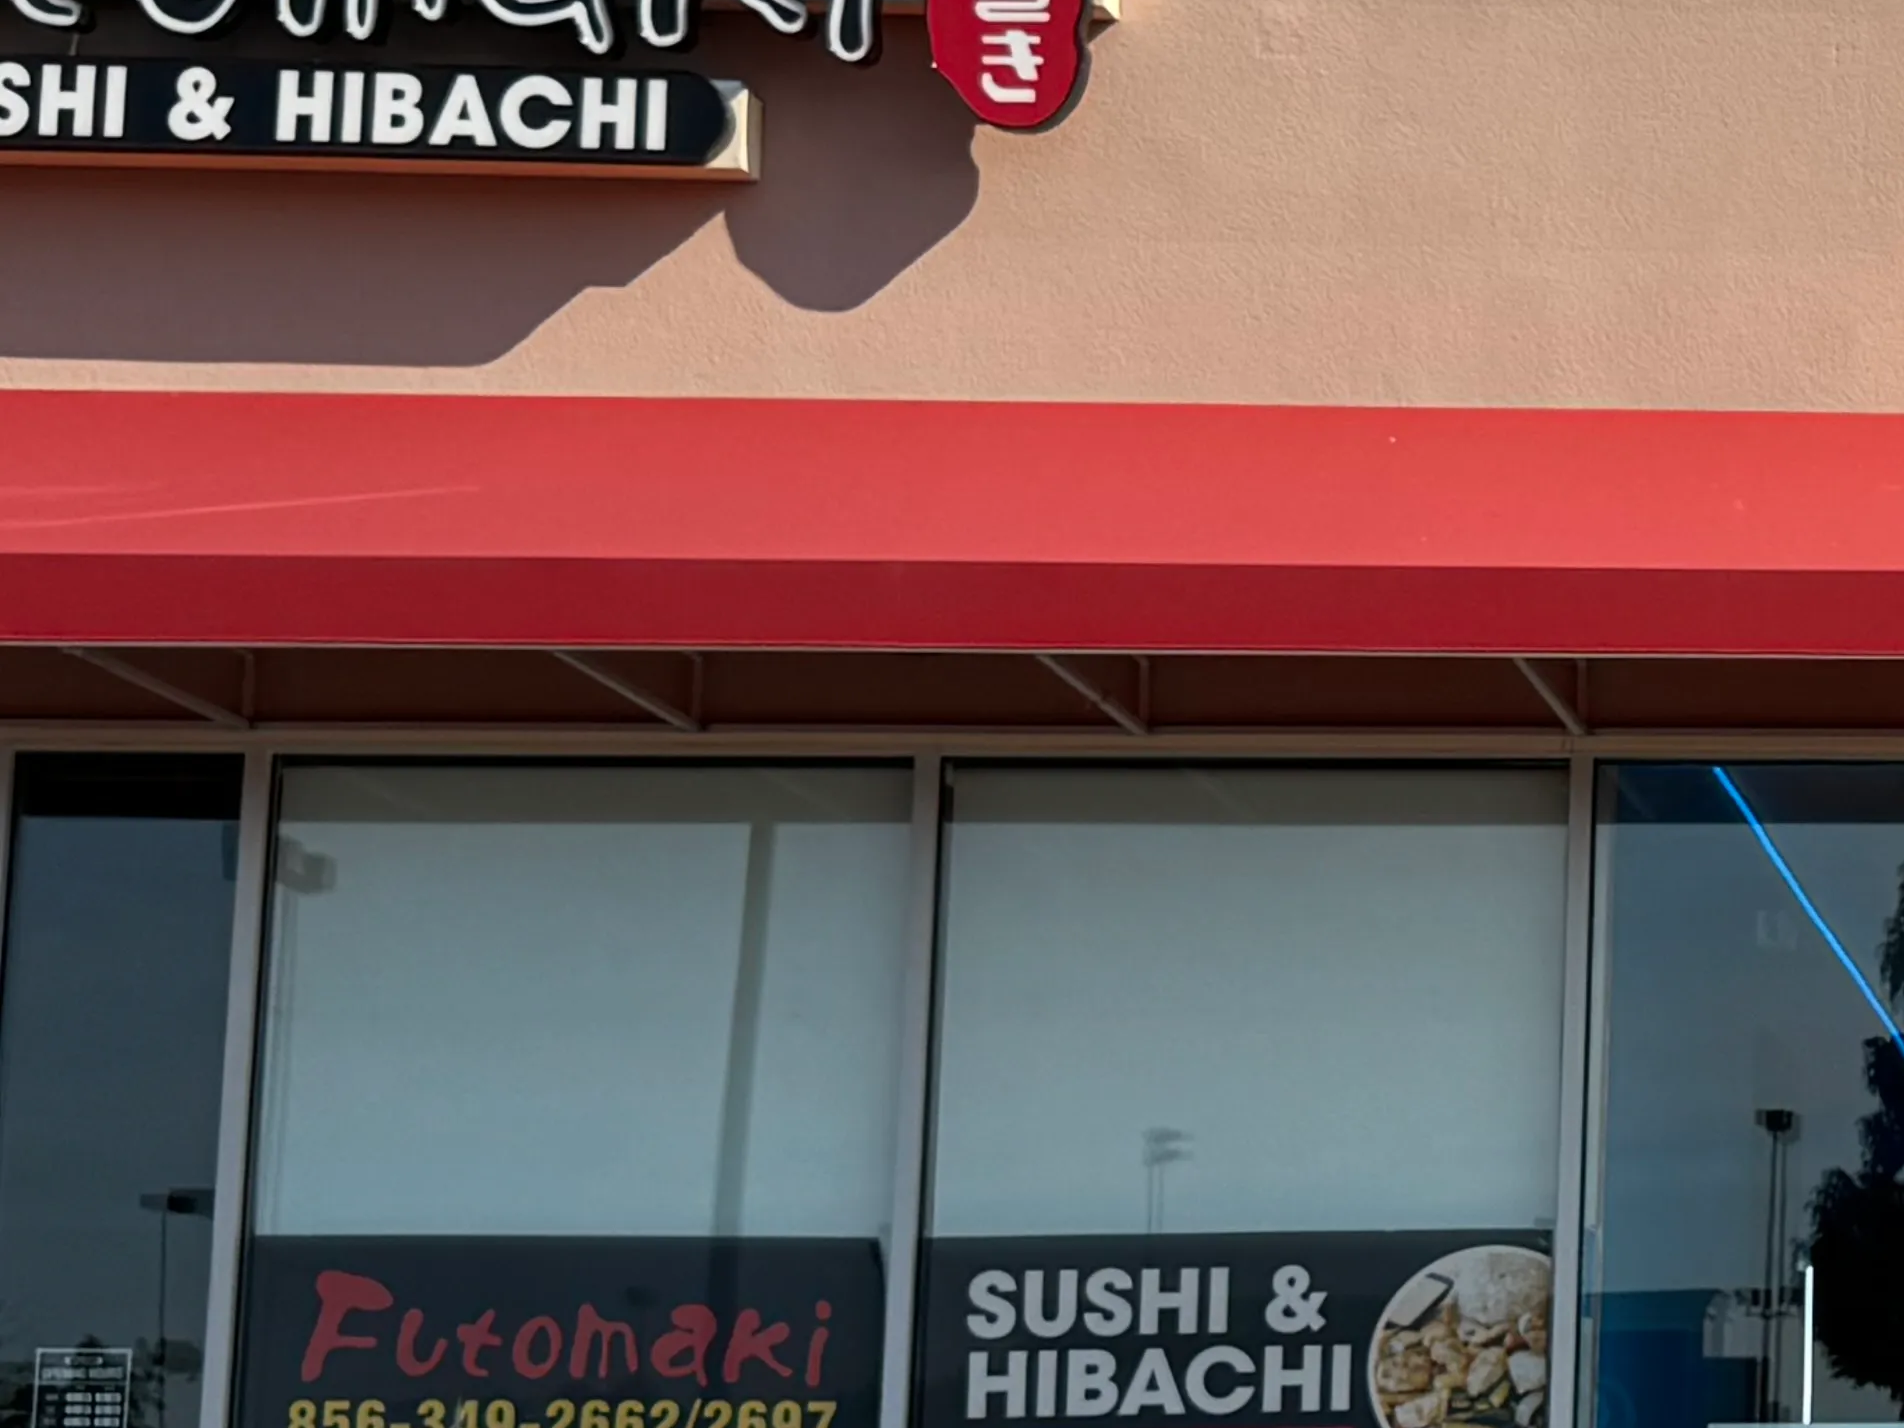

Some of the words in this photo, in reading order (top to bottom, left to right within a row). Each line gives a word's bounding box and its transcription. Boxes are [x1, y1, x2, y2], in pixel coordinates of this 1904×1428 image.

[168, 67, 235, 142] &
[276, 68, 668, 152] HIBACHI
[301, 1269, 833, 1387] Futomaki
[966, 1267, 1230, 1339] SUSHI
[1265, 1264, 1327, 1333] &
[965, 1344, 1353, 1419] HIBACHI
